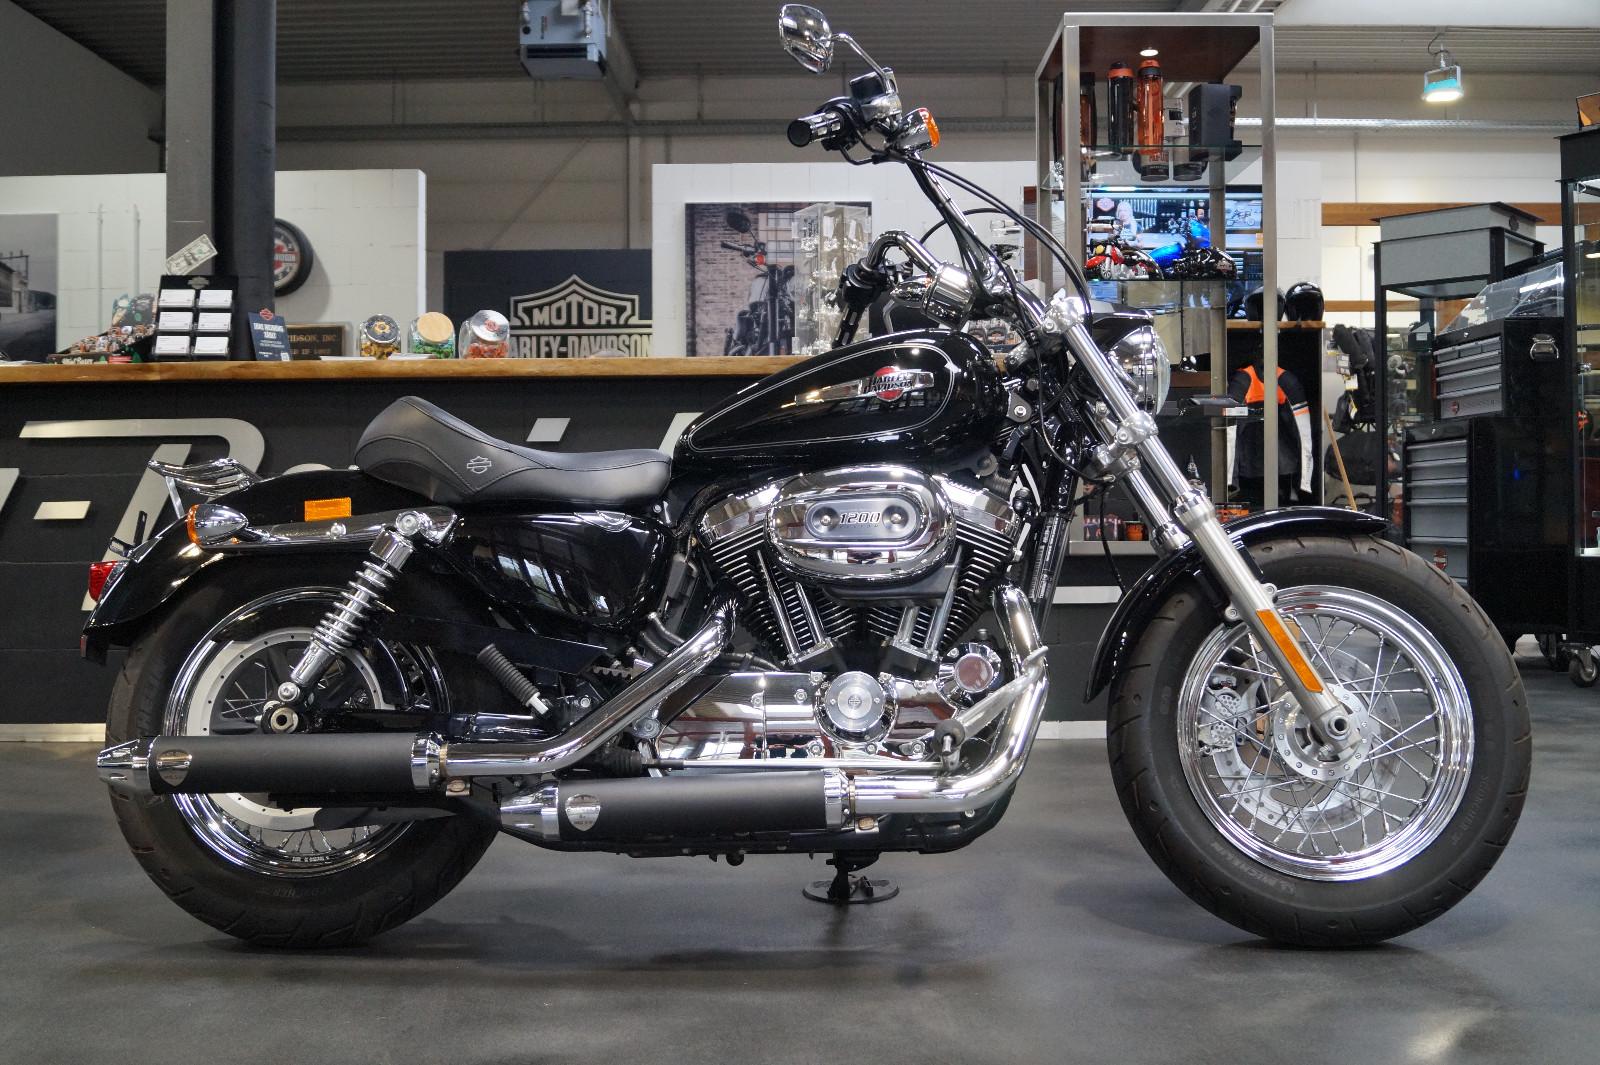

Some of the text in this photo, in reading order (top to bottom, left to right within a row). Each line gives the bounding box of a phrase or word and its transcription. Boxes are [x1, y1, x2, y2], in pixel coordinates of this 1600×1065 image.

[532, 294, 618, 326] MOTOR
[509, 334, 652, 359] ARLEY-DAVIDSON
[839, 511, 881, 524] 1200
